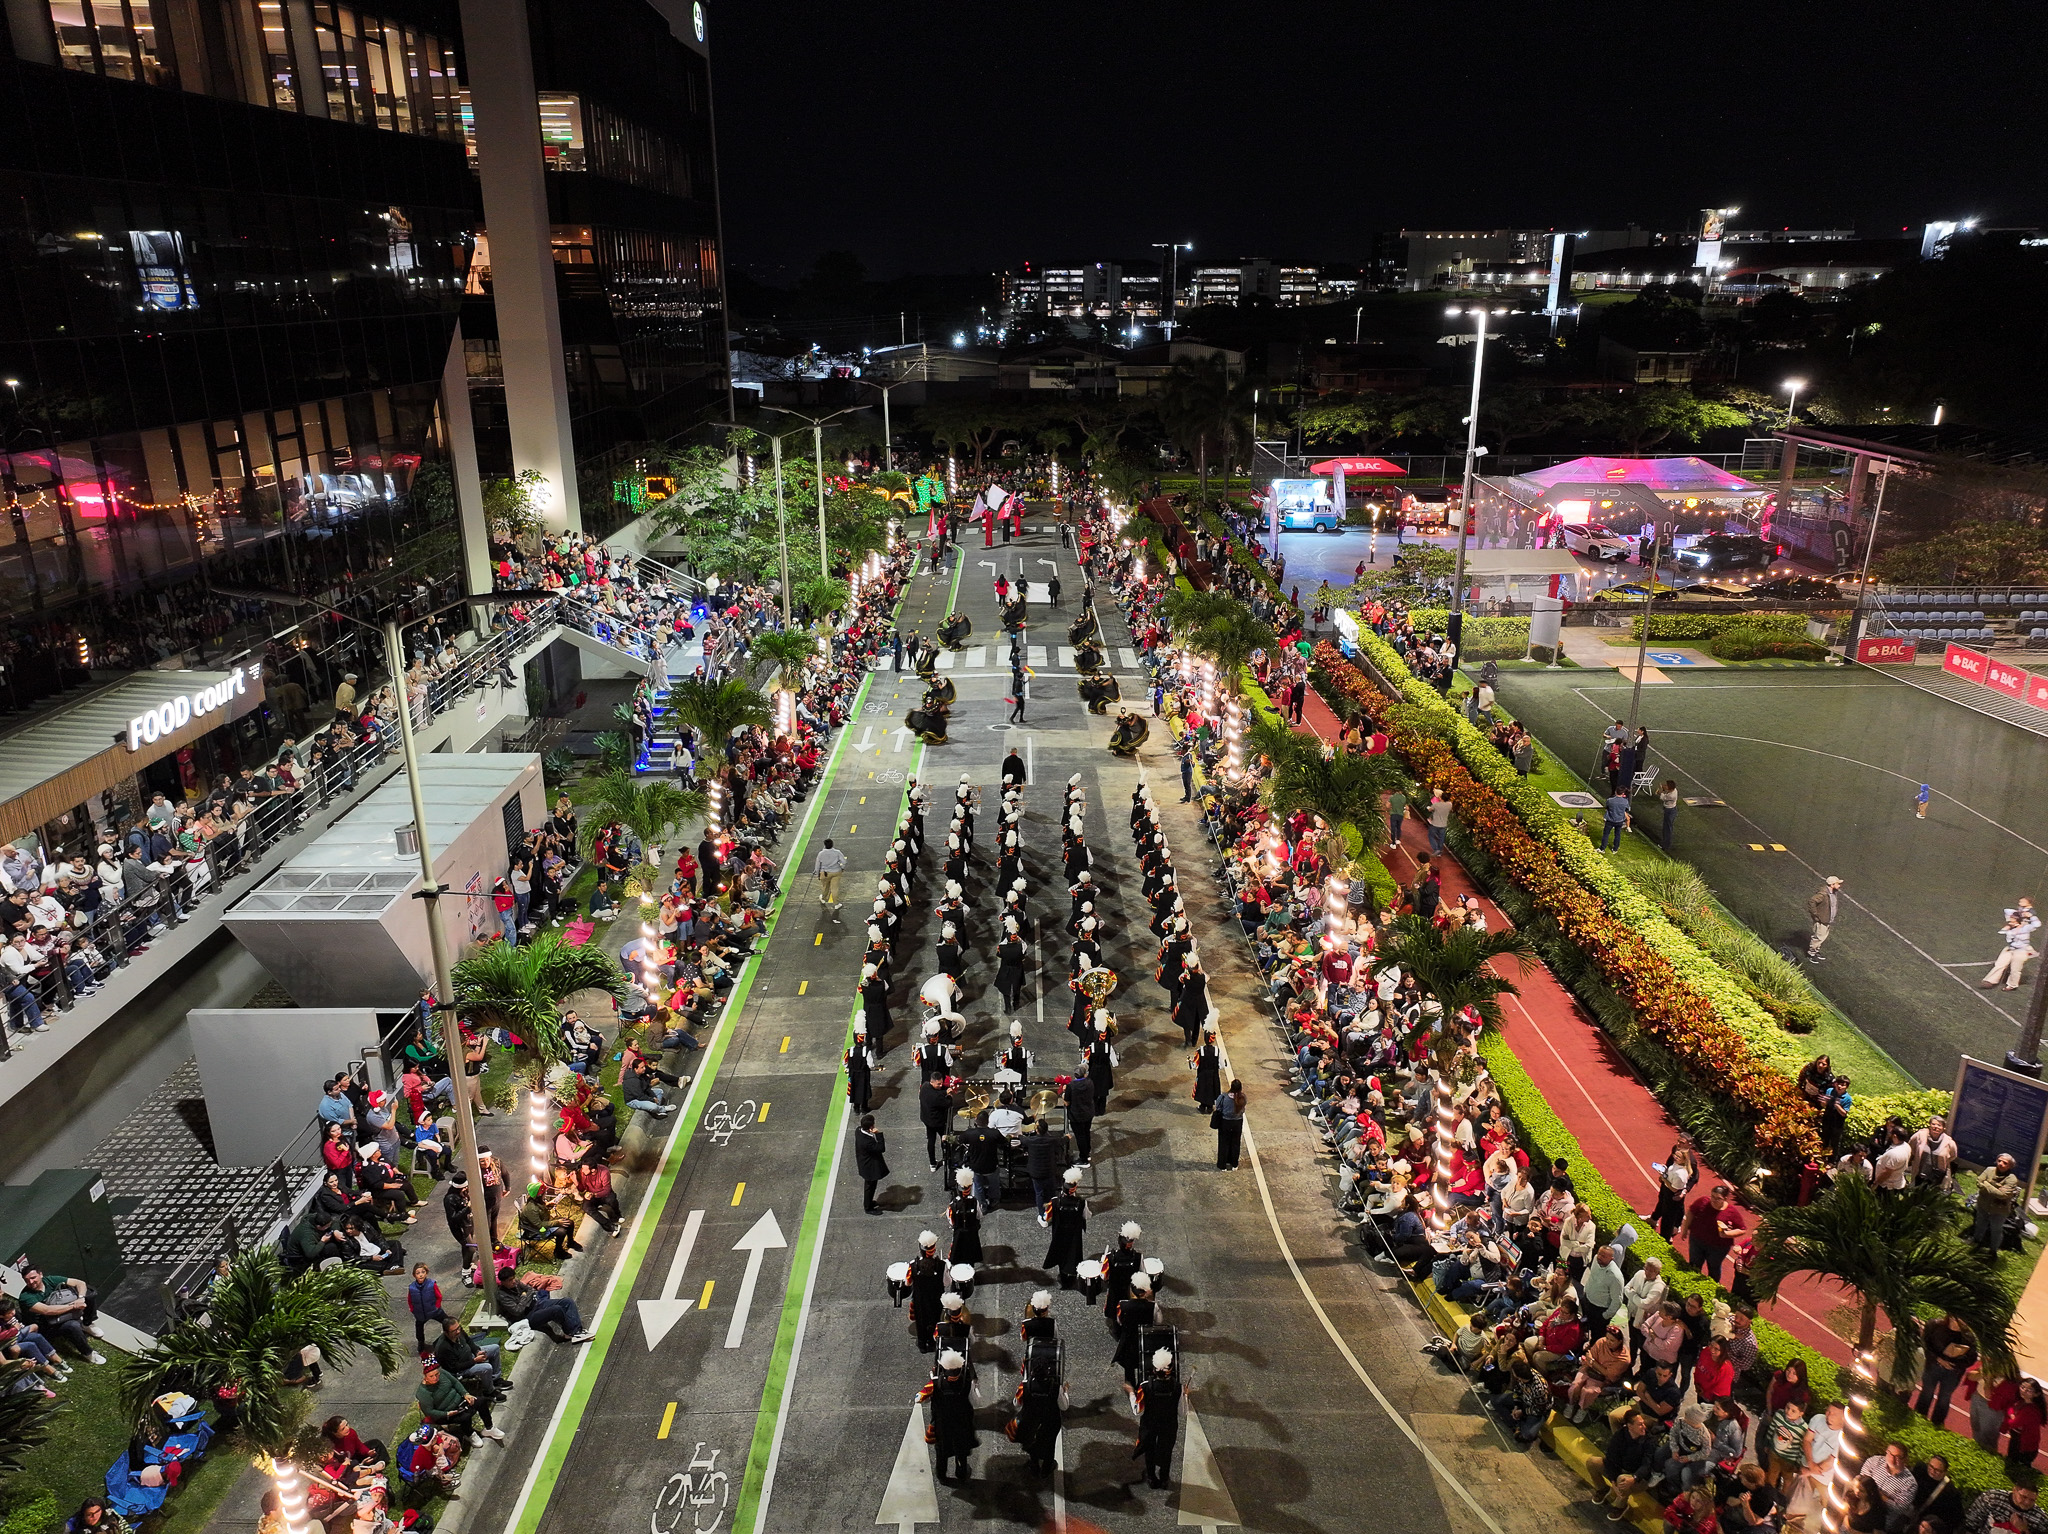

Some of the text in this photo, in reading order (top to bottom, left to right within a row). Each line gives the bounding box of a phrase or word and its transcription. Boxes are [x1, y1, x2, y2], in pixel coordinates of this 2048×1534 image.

[1355, 462, 1381, 470] BAC
[1584, 488, 1621, 497] BYD
[1881, 645, 1906, 656] BAC
[1961, 657, 1980, 674] BAC
[1999, 671, 2019, 689] BAC
[127, 666, 246, 751] FOOD court
